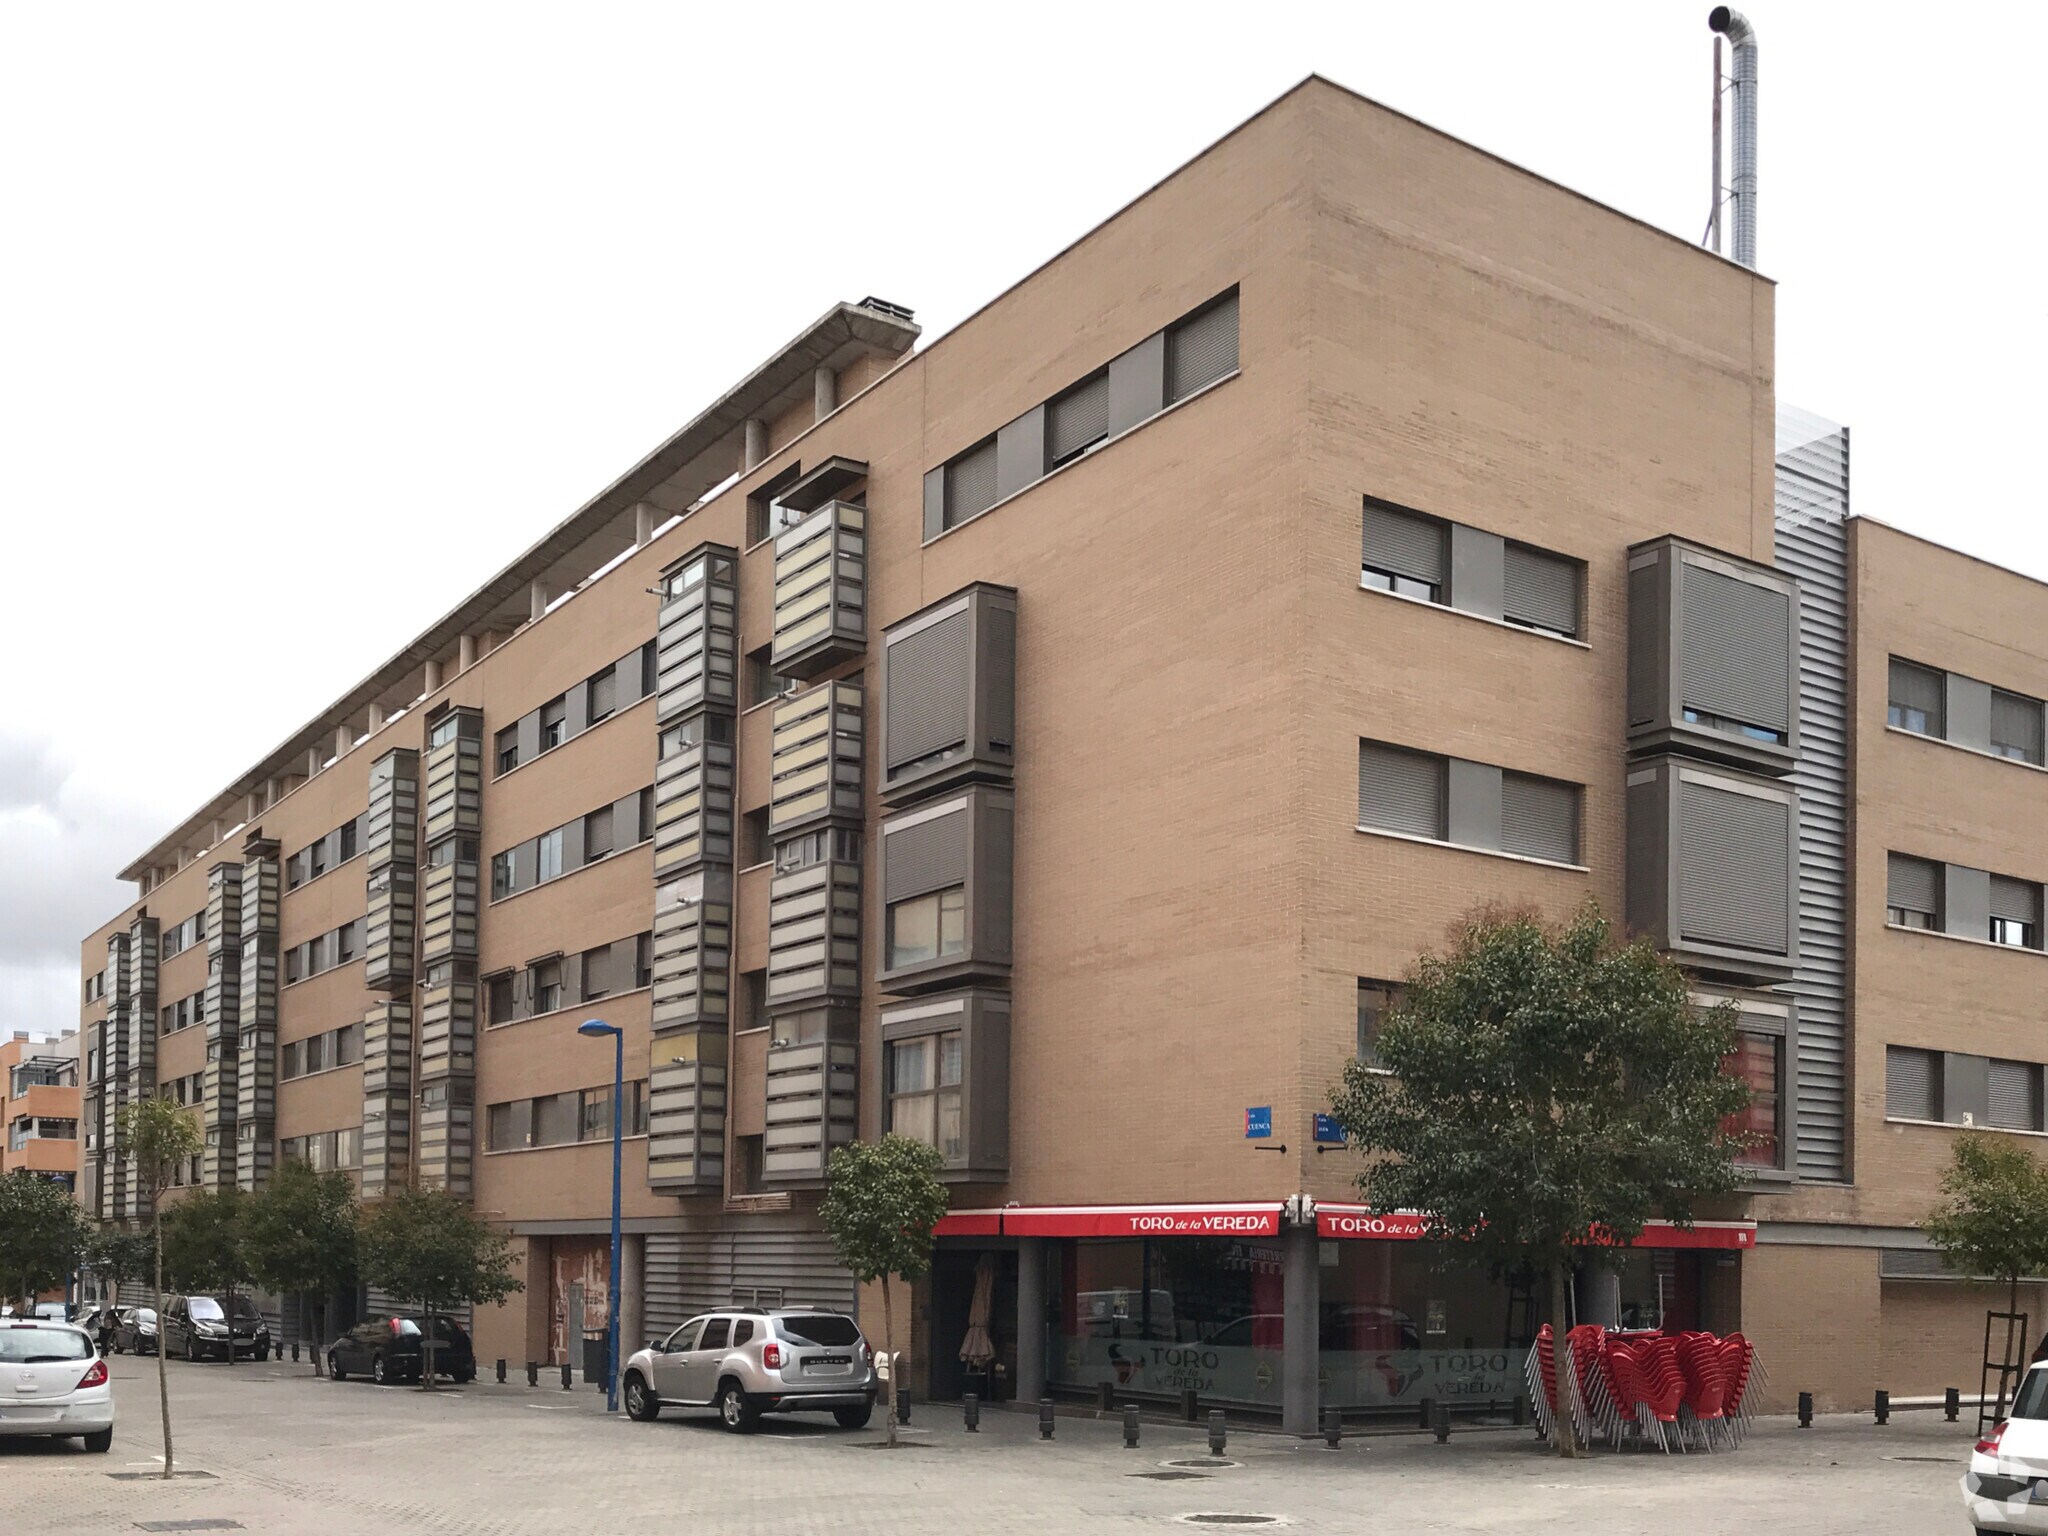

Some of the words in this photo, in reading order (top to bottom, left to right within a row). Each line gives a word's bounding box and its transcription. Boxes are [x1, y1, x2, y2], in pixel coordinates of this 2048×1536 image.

[1247, 1122, 1271, 1131] CUENCA
[1130, 1216, 1175, 1231] TORO
[1175, 1220, 1188, 1231] de
[1189, 1219, 1201, 1231] la
[1202, 1215, 1270, 1231] VEREDA
[1327, 1217, 1385, 1233] TORO
[1387, 1223, 1402, 1235] de
[1405, 1224, 1419, 1235] la
[1150, 1347, 1219, 1370] TORO
[1429, 1354, 1508, 1373] TORO
[1173, 1367, 1186, 1376] de
[1187, 1368, 1199, 1377] la
[1154, 1375, 1215, 1392] VEREDA
[1434, 1381, 1505, 1394] VEREDA
